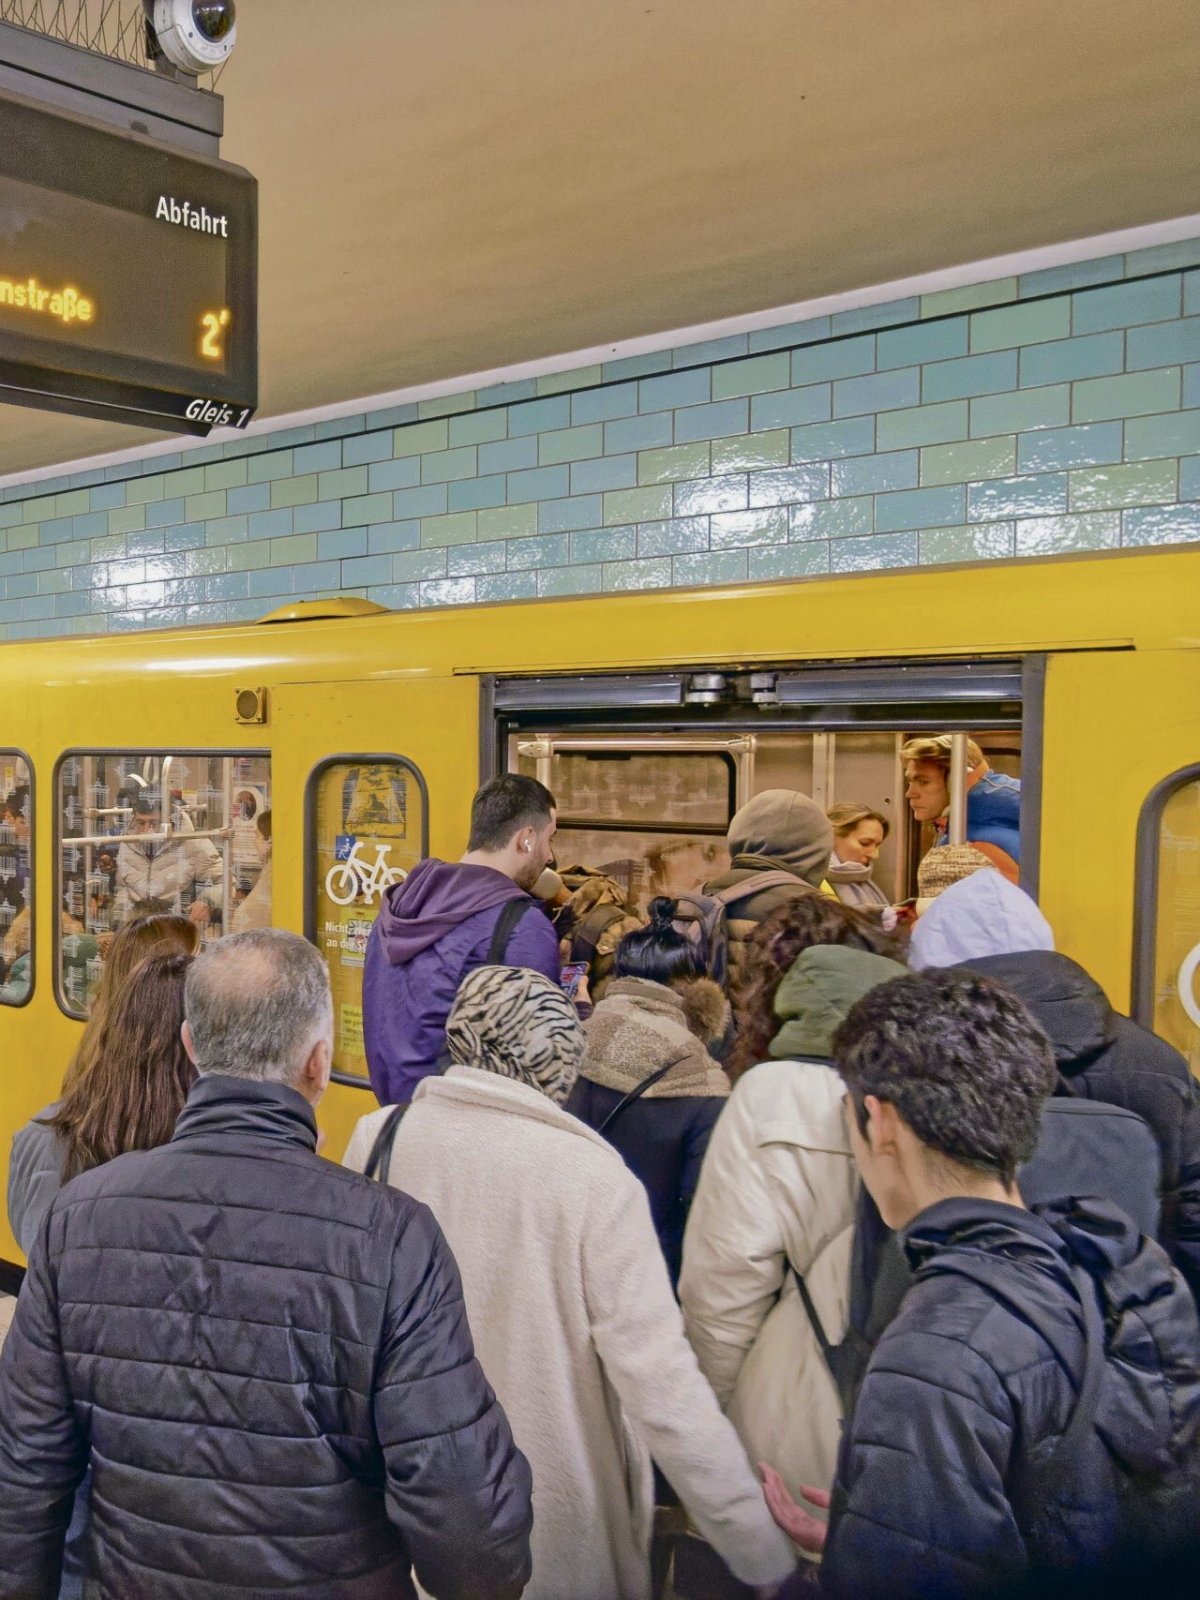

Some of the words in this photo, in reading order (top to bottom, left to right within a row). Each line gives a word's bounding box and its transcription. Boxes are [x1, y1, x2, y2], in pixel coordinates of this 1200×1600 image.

[155, 195, 228, 238] Abfahrt
[185, 399, 233, 425] Gleis
[235, 408, 250, 428] 1
